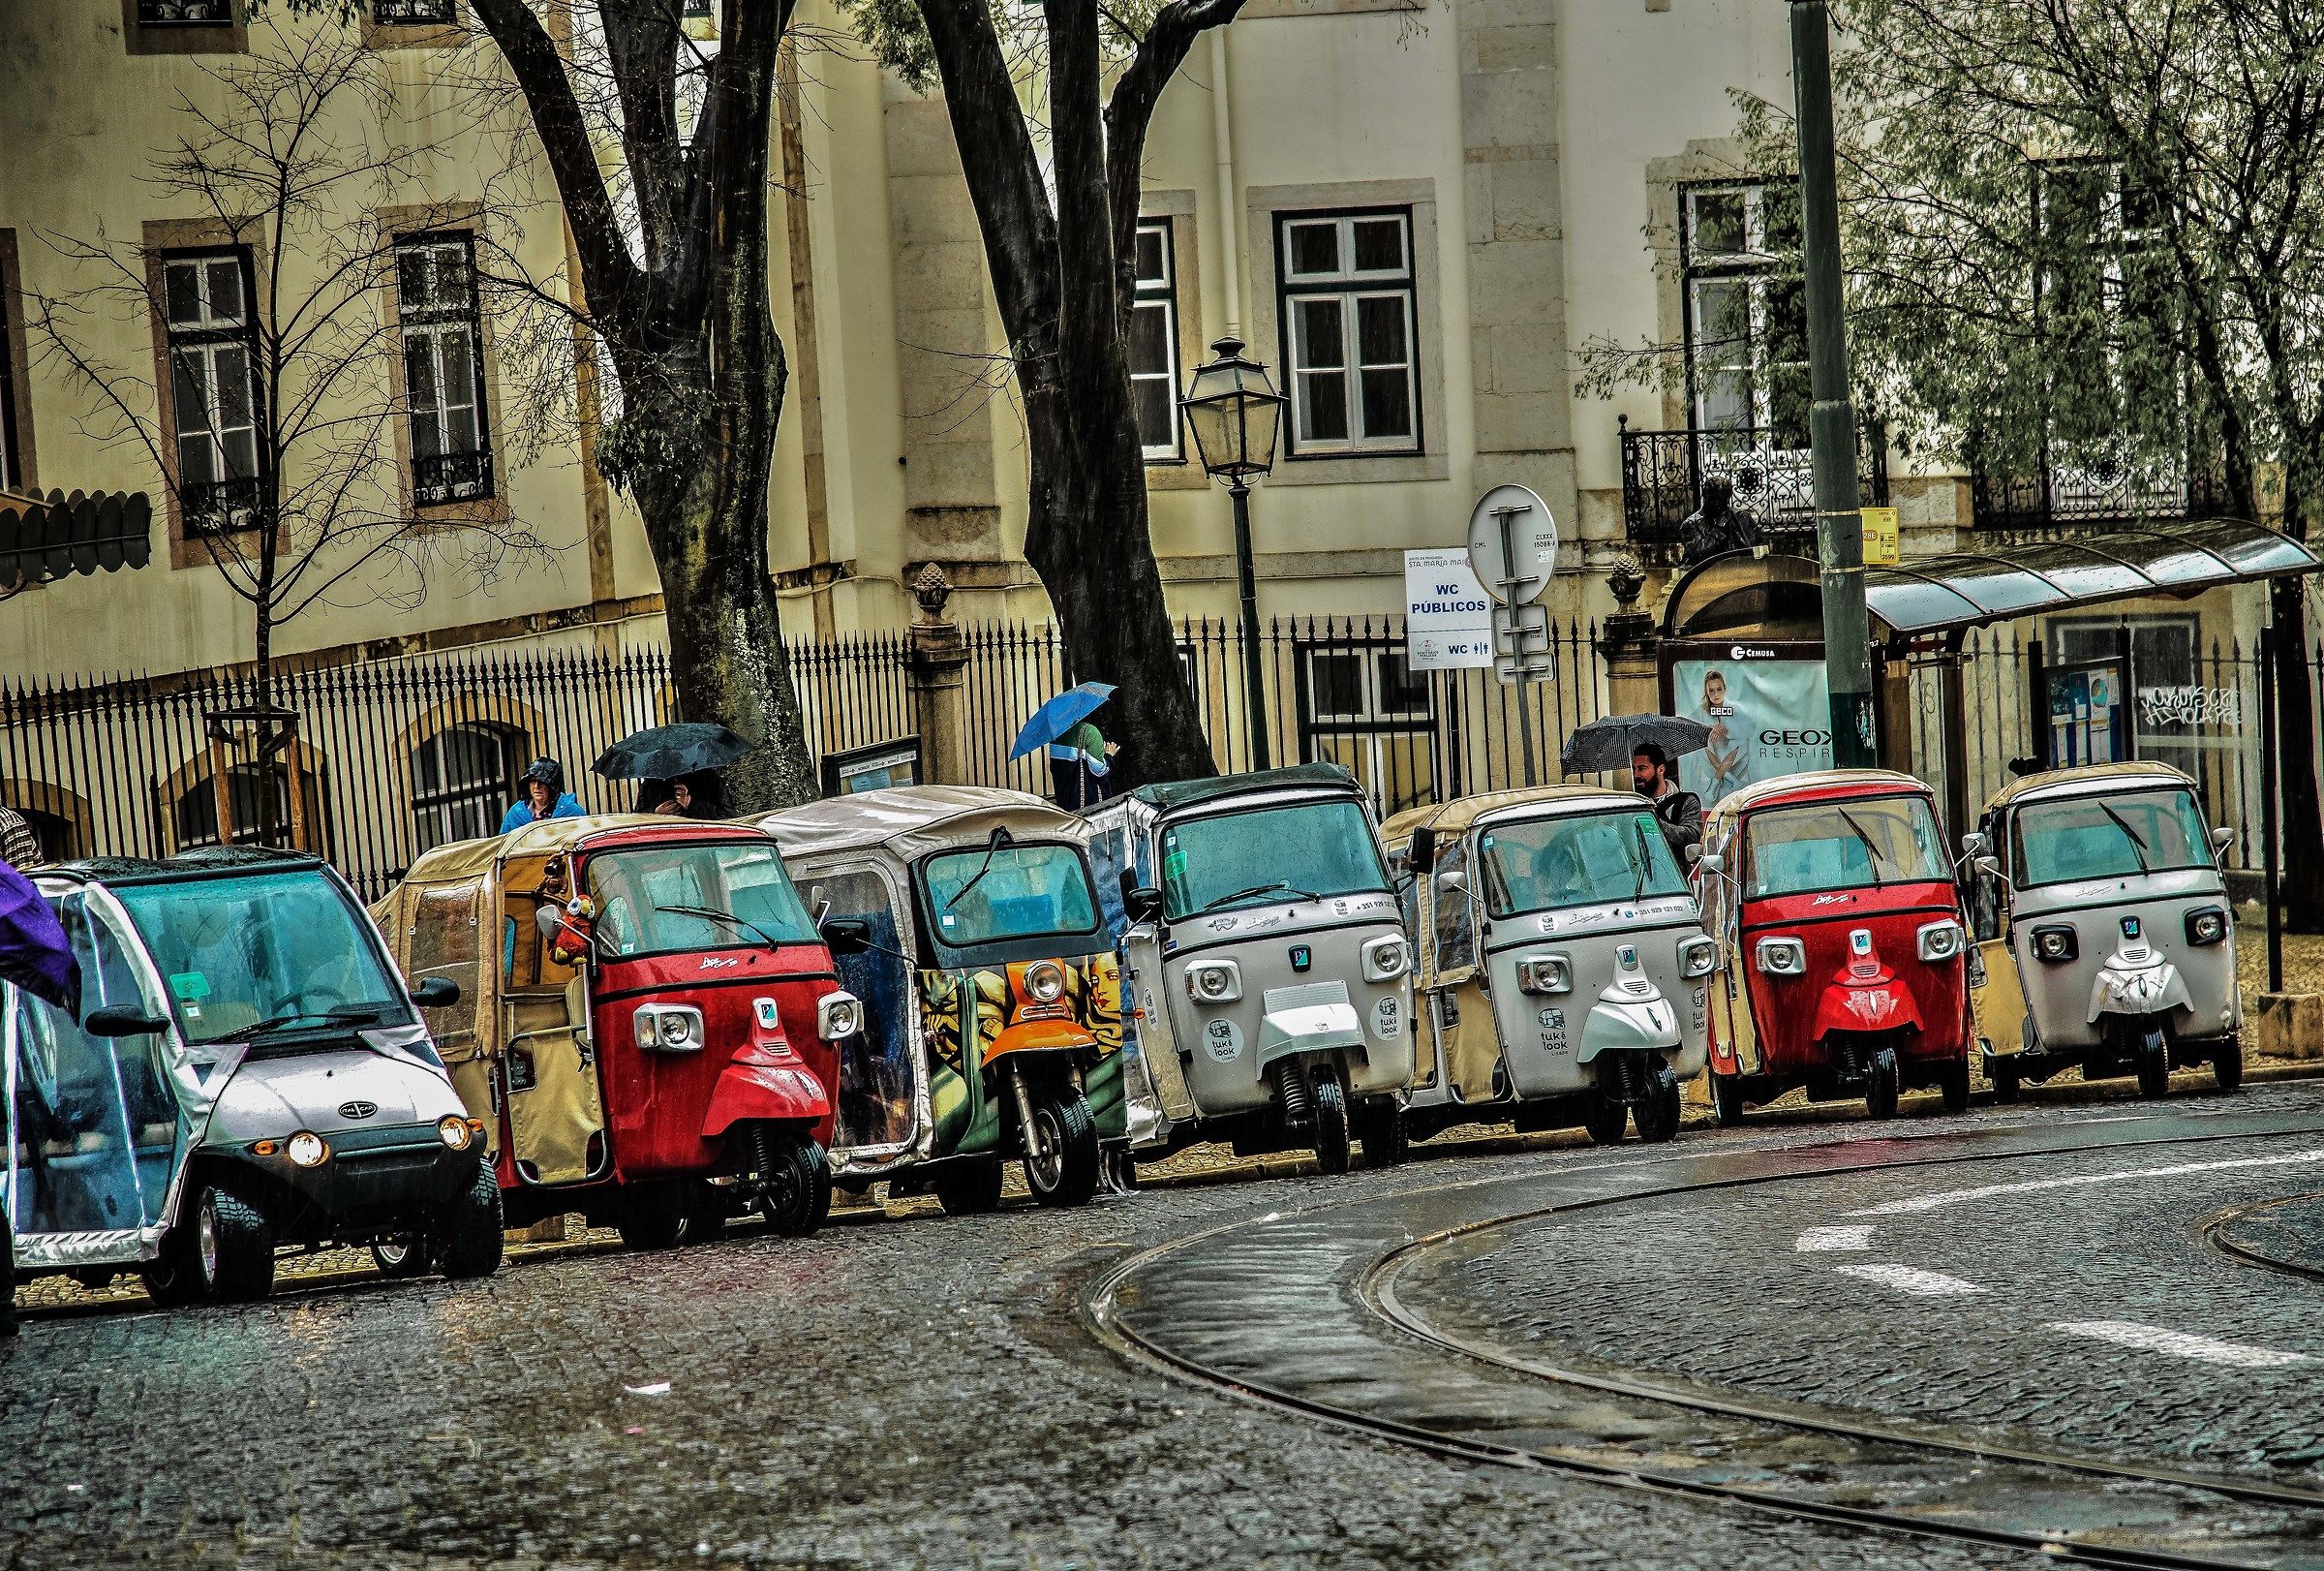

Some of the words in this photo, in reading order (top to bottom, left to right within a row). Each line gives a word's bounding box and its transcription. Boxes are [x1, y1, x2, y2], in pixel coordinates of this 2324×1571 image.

[1435, 584, 1459, 595] WC
[1411, 601, 1486, 614] PÚBLICOS
[1448, 645, 1468, 655] WC
[1381, 1026, 1397, 1034] look
[1543, 1041, 1568, 1050] look
